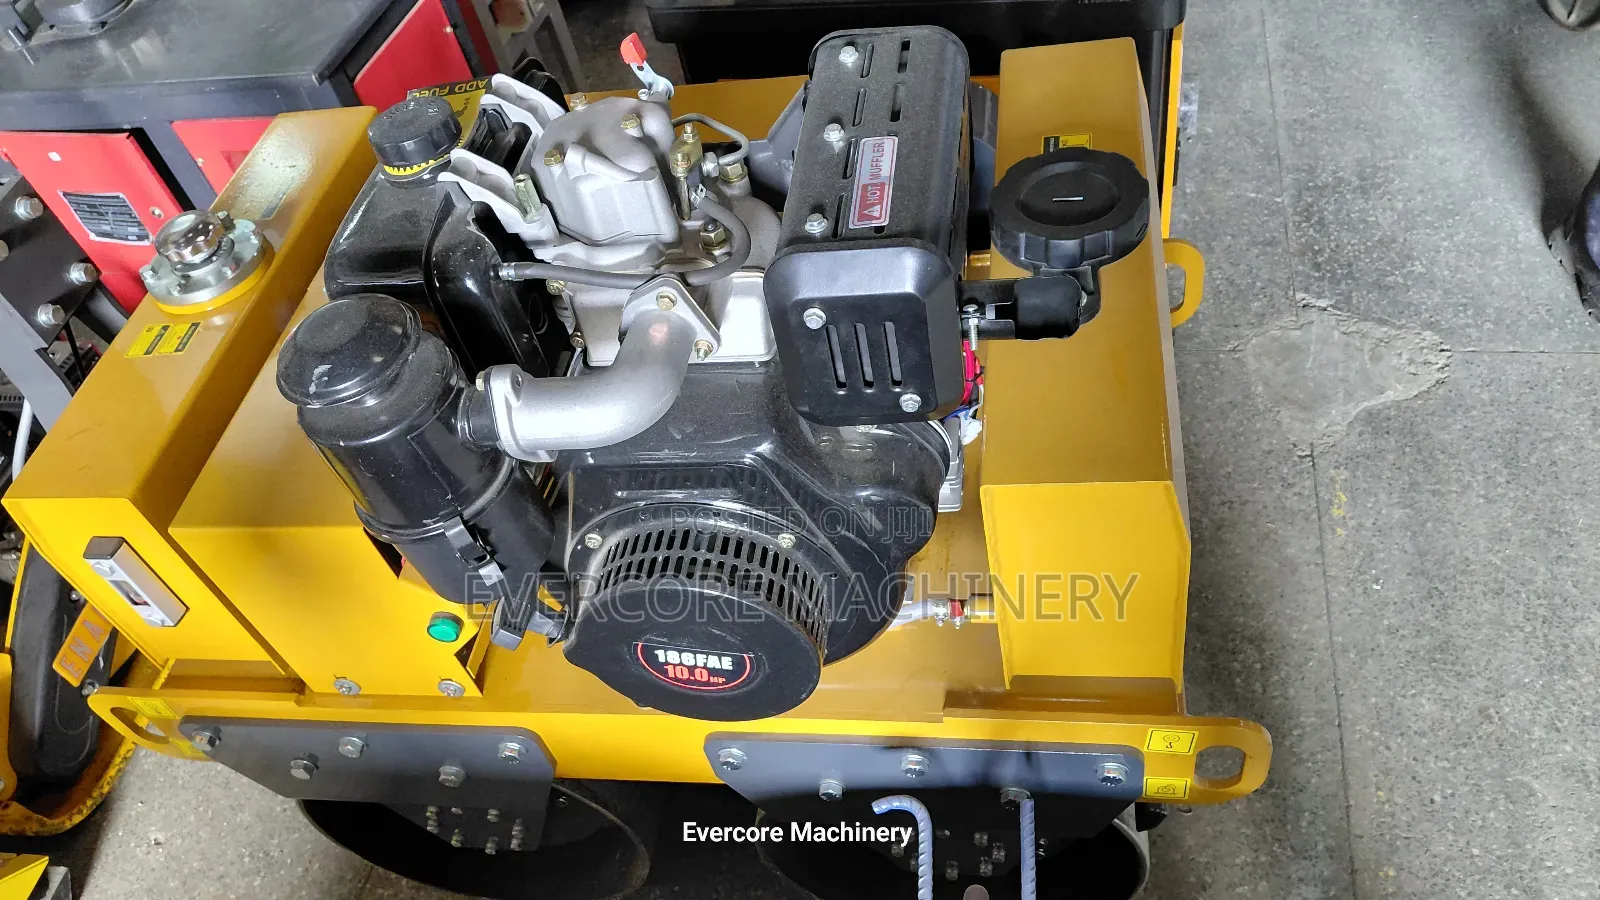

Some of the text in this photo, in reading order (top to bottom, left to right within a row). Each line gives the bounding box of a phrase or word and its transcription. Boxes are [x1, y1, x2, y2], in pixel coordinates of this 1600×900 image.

[454, 78, 489, 92] ADD
[865, 141, 886, 204] HOT MUFFLER
[60, 606, 112, 678] ENA
[654, 649, 733, 670] 186FAE
[664, 664, 709, 682] 10.0
